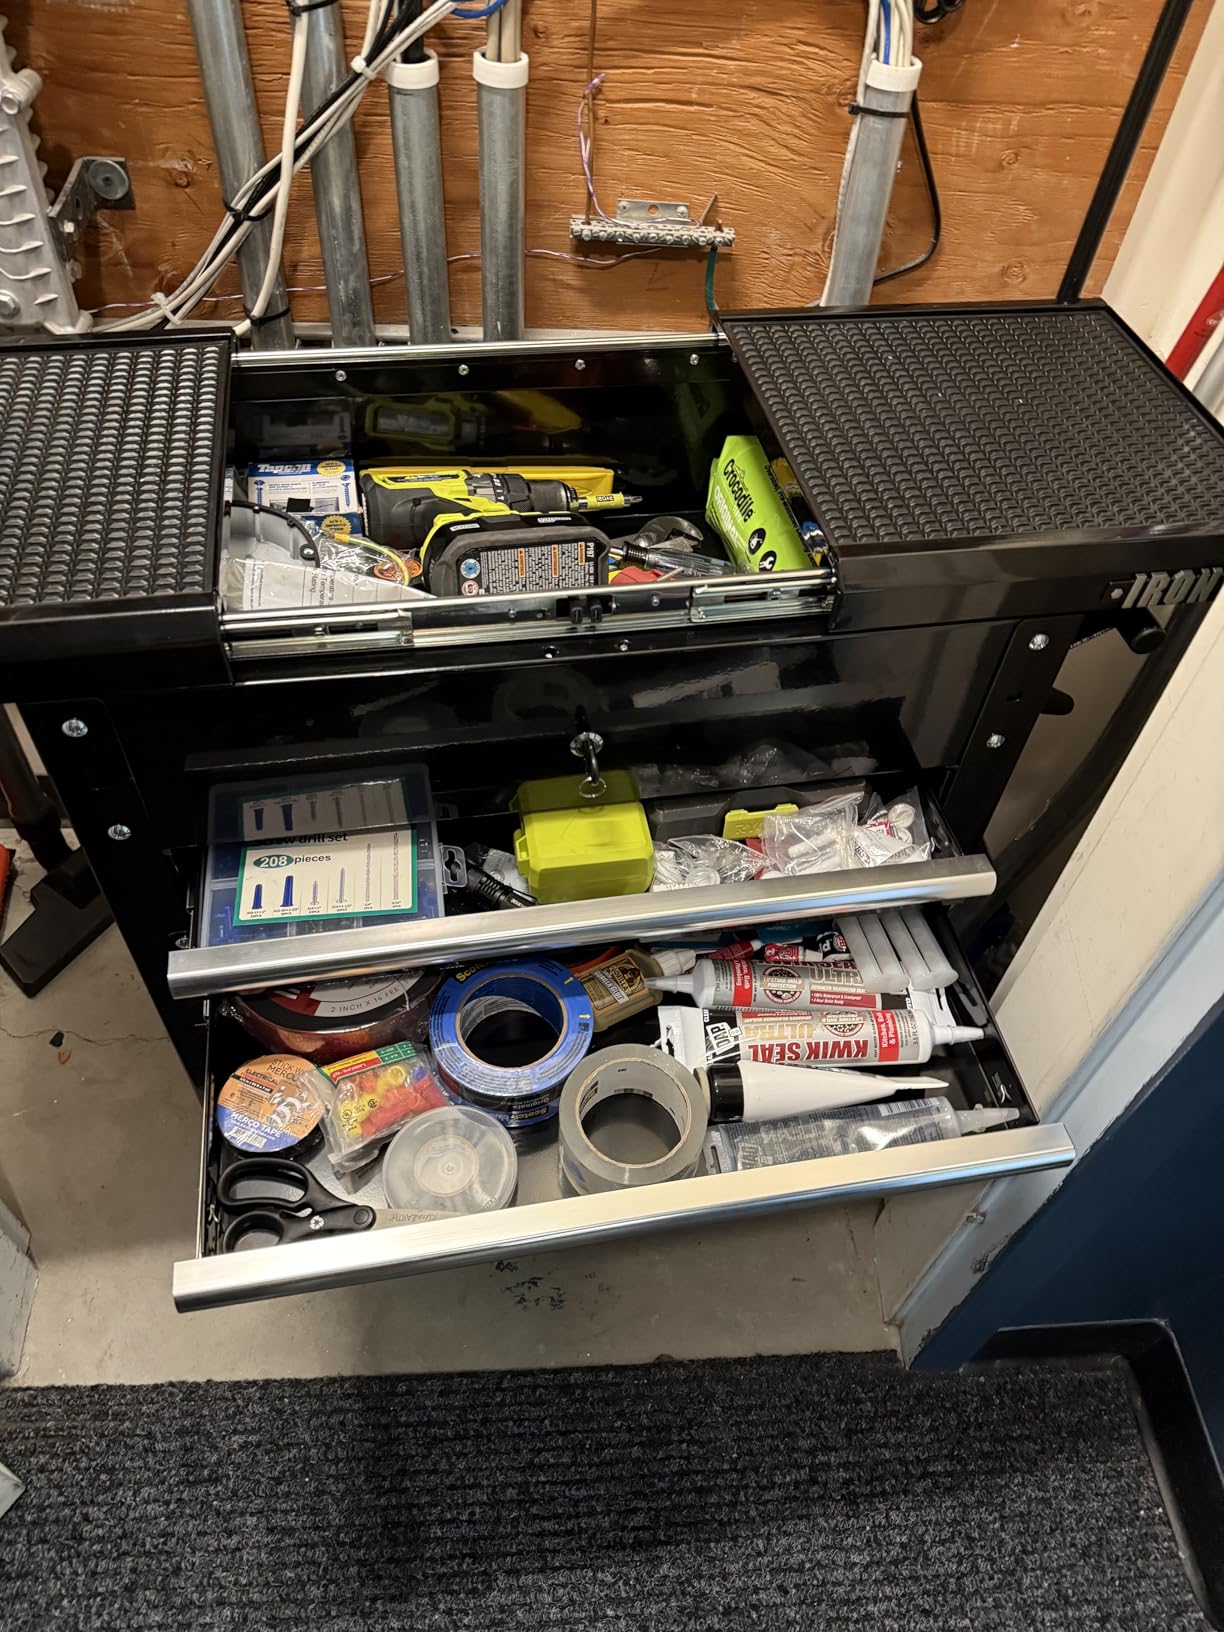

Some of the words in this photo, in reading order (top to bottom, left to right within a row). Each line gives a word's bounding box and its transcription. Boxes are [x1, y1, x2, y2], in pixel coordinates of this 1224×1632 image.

[723, 458, 755, 523] Crocodile
[1121, 567, 1224, 609] IRON
[299, 834, 325, 844] drill
[327, 832, 349, 842] set
[260, 856, 288, 868] 208
[294, 855, 331, 864] pieces
[808, 968, 864, 986] ULTR
[339, 1002, 362, 1012] INCH
[385, 986, 401, 997] FEE
[743, 1023, 814, 1041] ULTRA
[749, 1042, 801, 1065] SEAL
[806, 1039, 869, 1061] KWIK
[271, 1058, 295, 1070] STICK
[245, 1068, 279, 1086] ELECTRICAL
[230, 1111, 260, 1128] MERCO
[261, 1123, 282, 1138] TAPE
